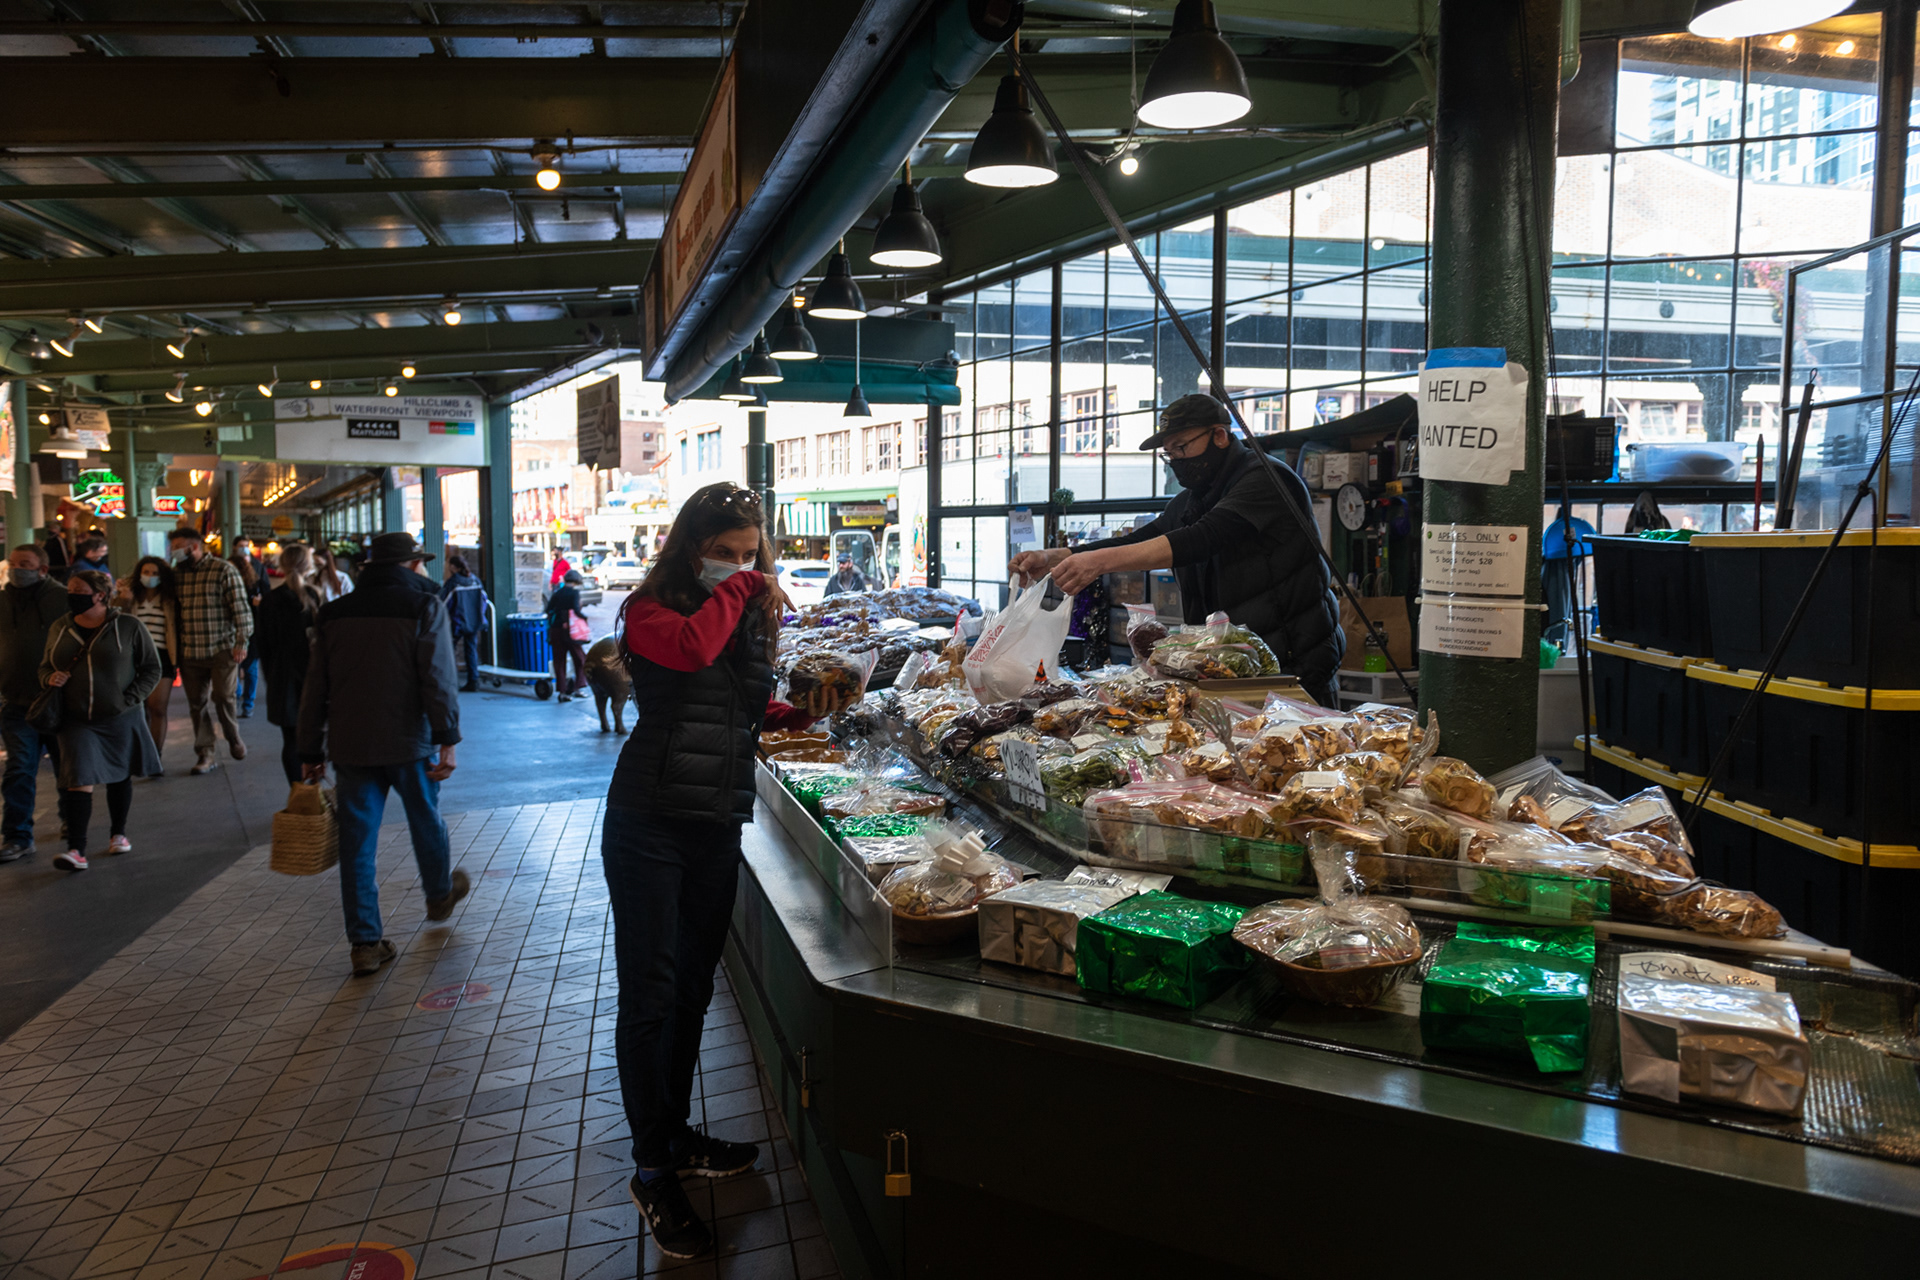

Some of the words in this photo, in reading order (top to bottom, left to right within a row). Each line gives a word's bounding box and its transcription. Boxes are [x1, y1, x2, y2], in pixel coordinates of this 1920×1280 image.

[1427, 380, 1487, 403] HELP
[403, 398, 460, 408] HILLCLIMB
[464, 400, 472, 408] &
[334, 404, 409, 416] WATERFRONT
[414, 407, 474, 418] VIEWPOINT
[1476, 533, 1501, 542] ONLY
[1461, 556, 1475, 565] for
[1443, 644, 1484, 652] UNDERSTANDING
